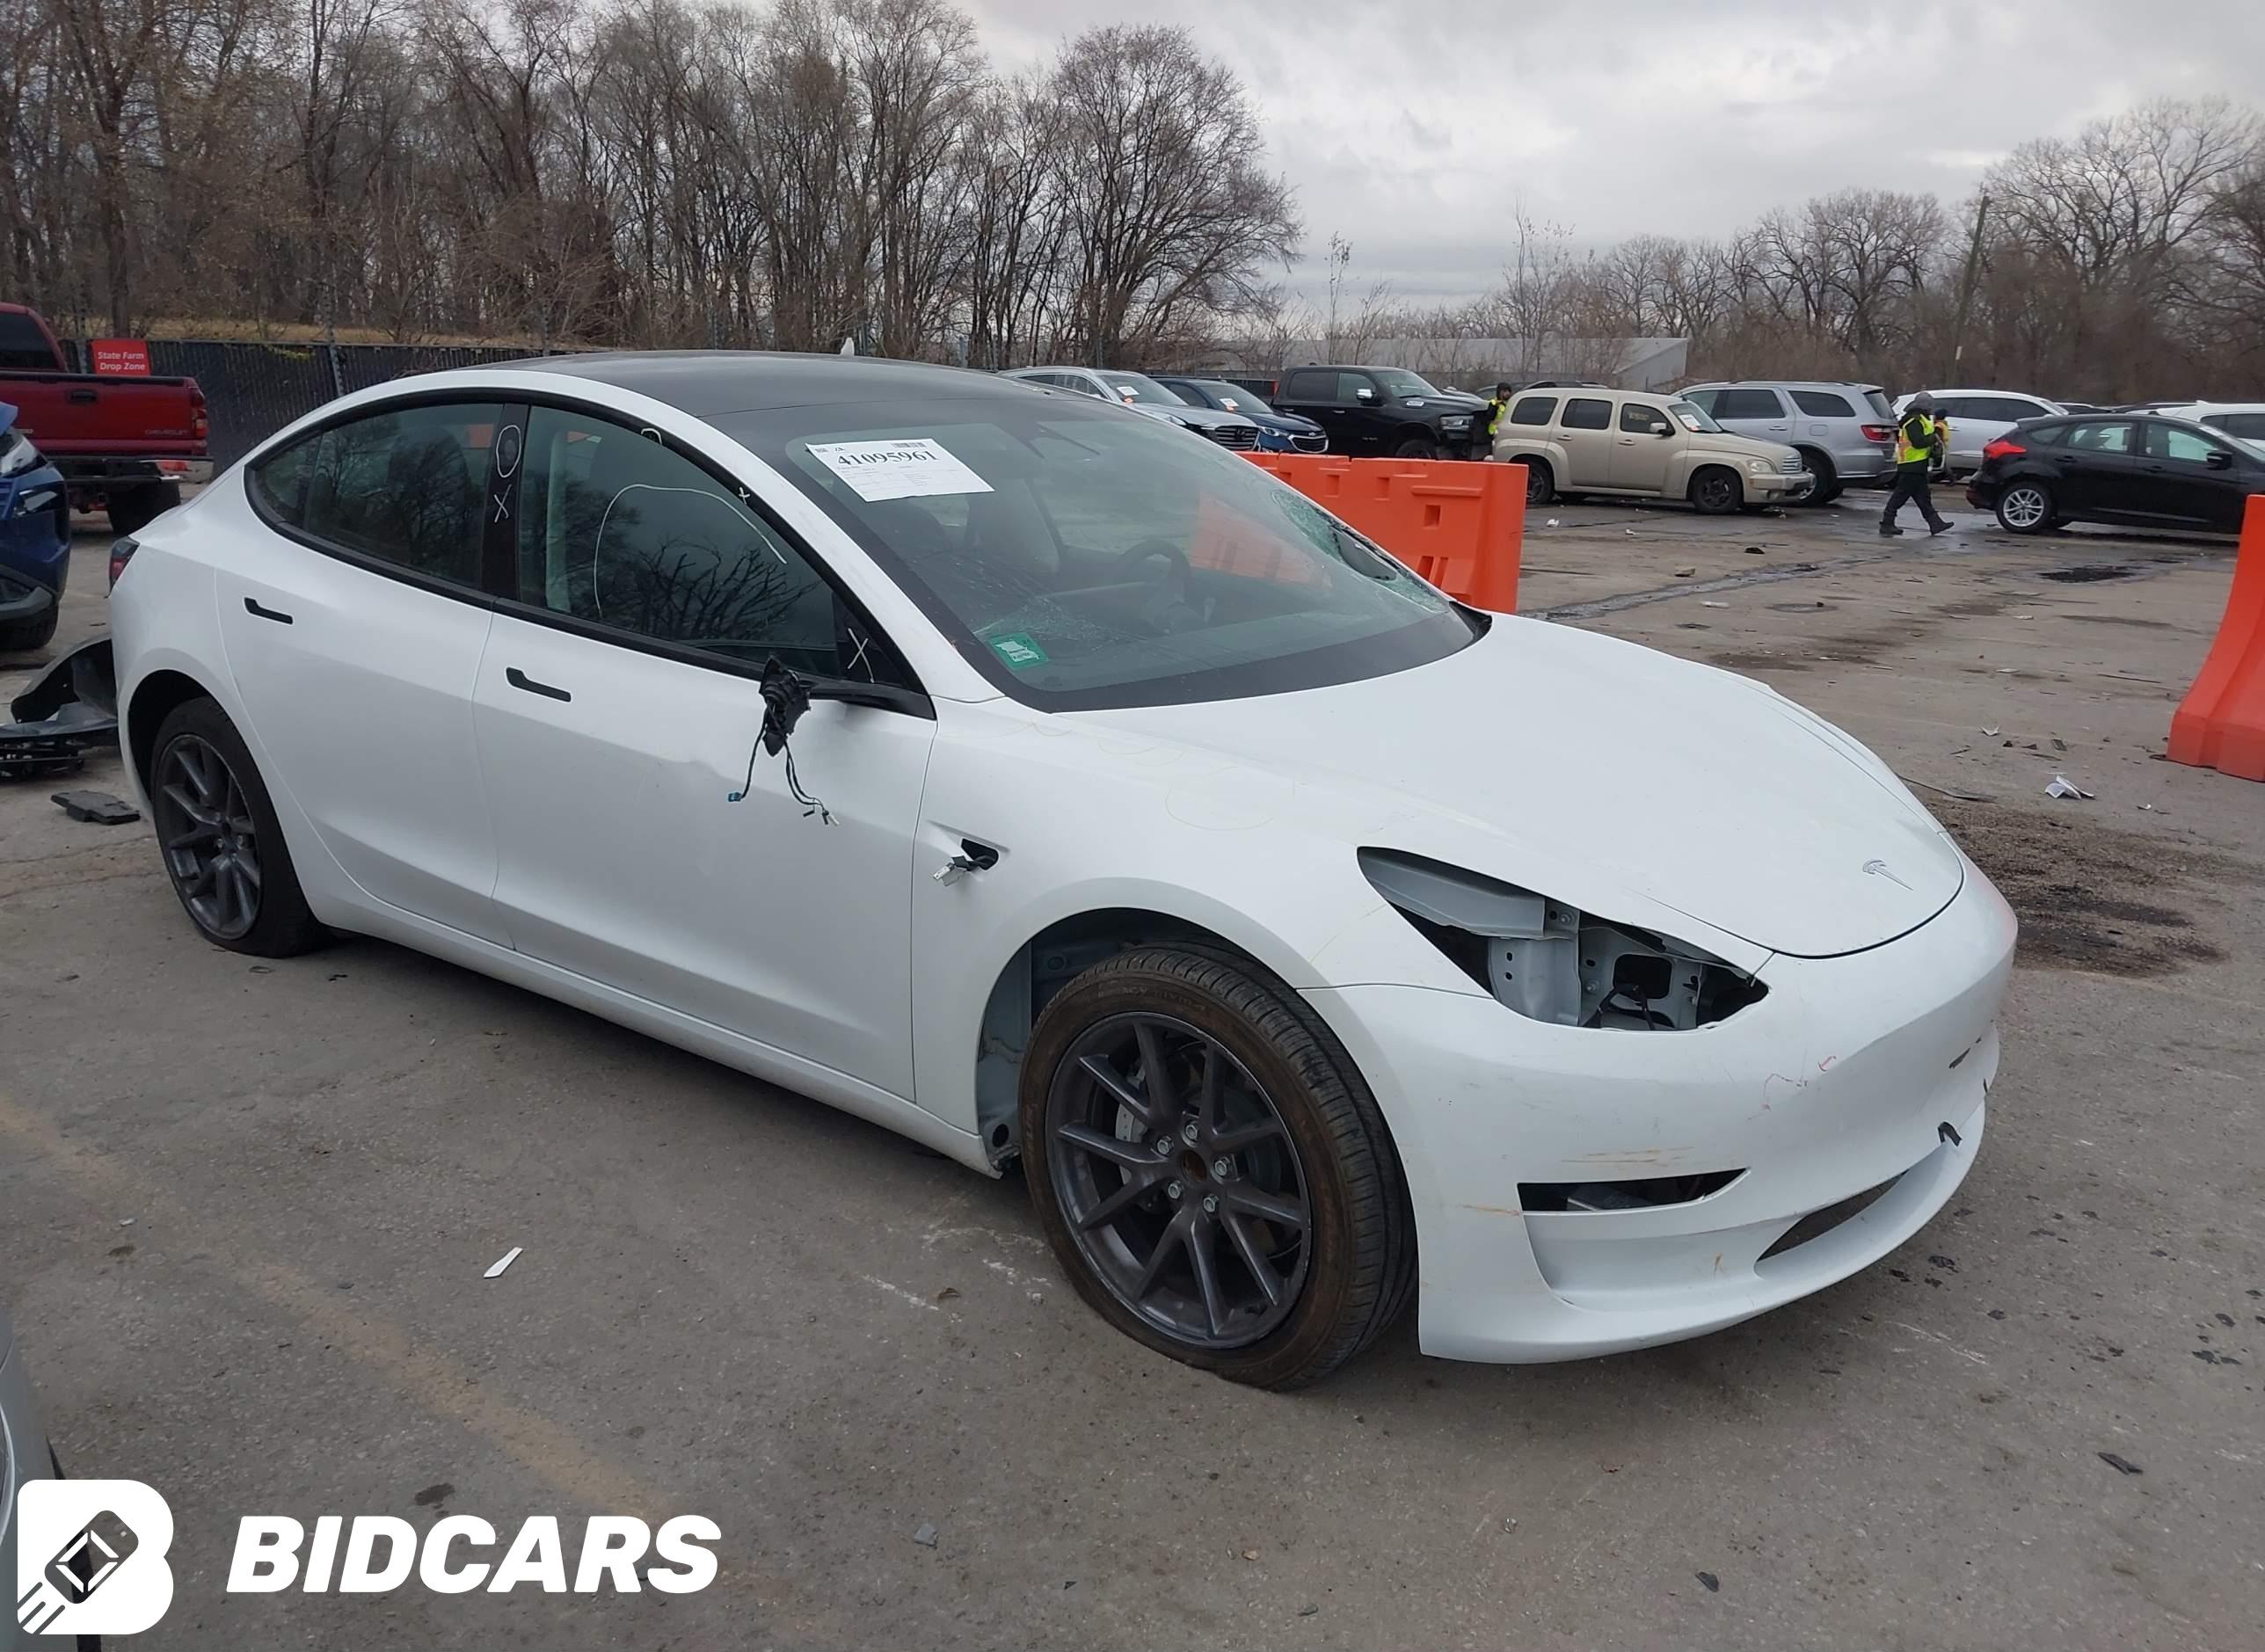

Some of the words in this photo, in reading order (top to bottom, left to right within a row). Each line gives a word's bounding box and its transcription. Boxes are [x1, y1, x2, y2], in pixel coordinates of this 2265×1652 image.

[99, 362, 122, 372] Drop
[123, 362, 146, 371] Zone
[838, 449, 941, 466] 41095961
